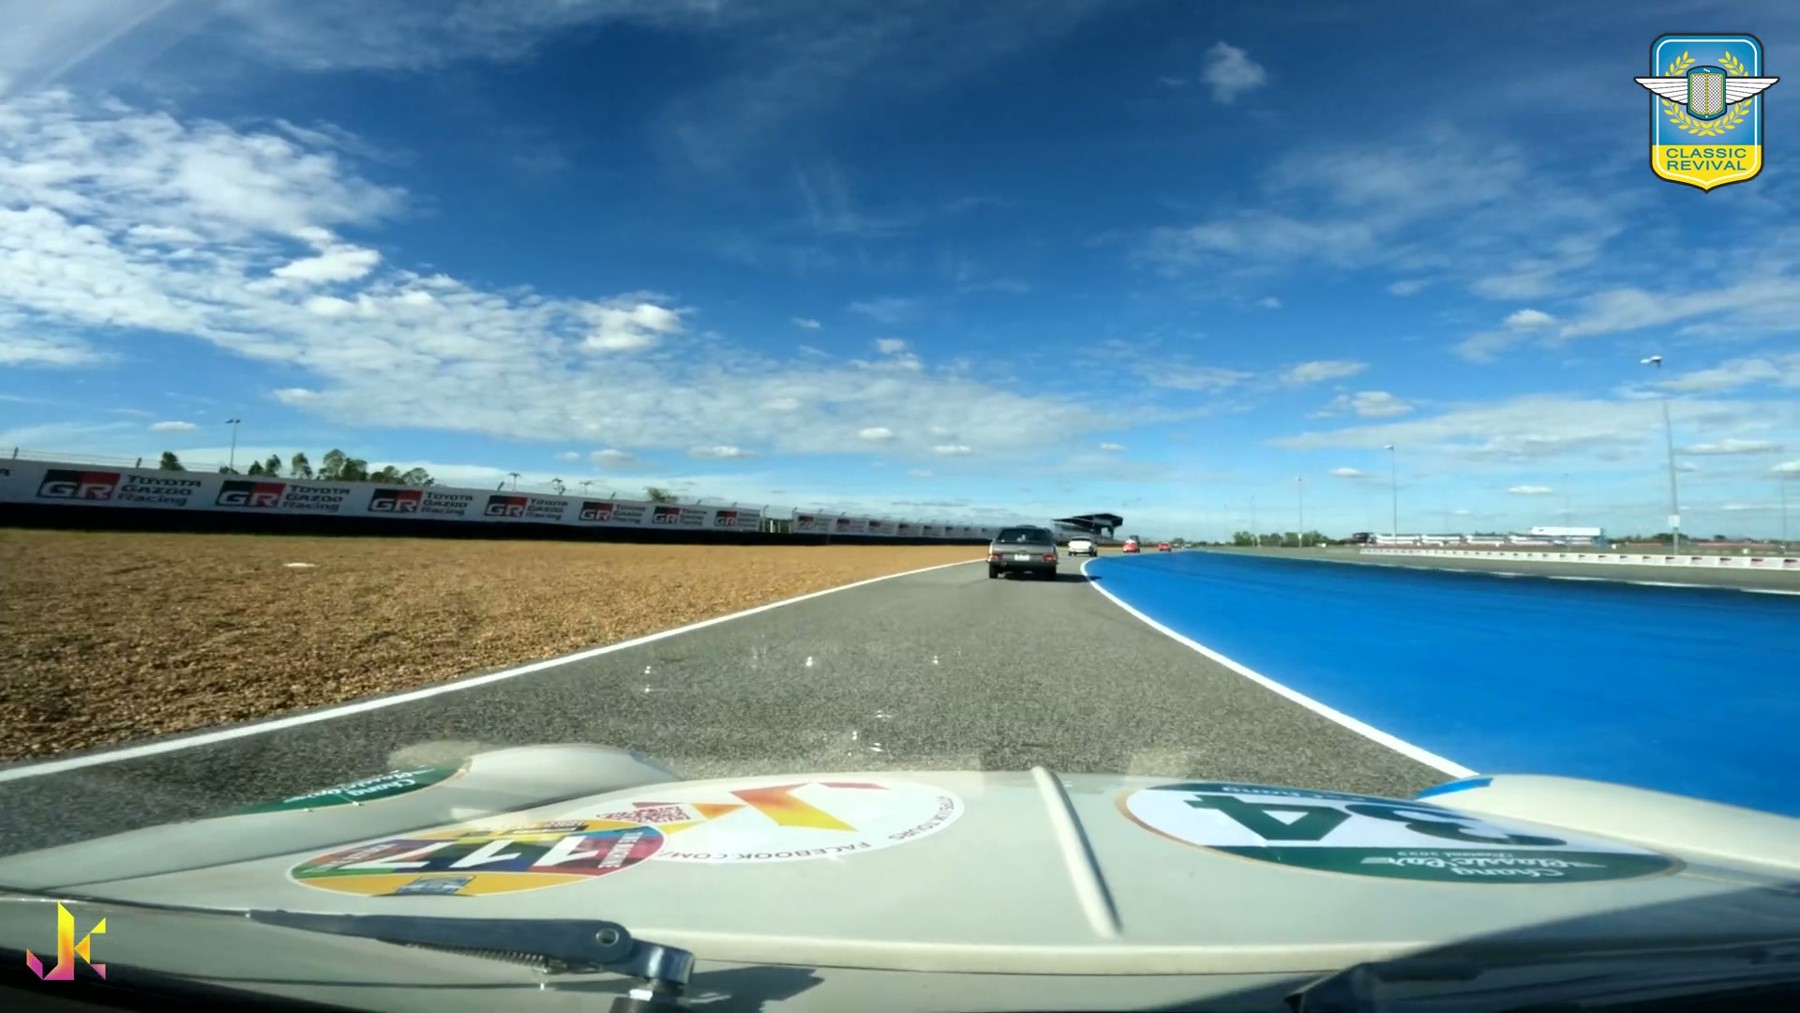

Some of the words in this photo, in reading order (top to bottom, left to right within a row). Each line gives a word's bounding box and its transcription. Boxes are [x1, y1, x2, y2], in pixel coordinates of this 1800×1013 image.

[127, 474, 201, 487] TOYOTA
[41, 481, 112, 500] GR
[121, 485, 192, 495] GAZOO
[289, 485, 350, 494] TOYOTA
[117, 494, 188, 506] Racing
[219, 491, 278, 507] GR
[285, 493, 343, 502] GAZOO
[282, 501, 339, 512] Racing
[372, 498, 417, 512] GR
[487, 503, 524, 517] GR
[1183, 795, 1568, 847] 34
[339, 835, 600, 869] 117
[1451, 867, 1564, 878] Chang
